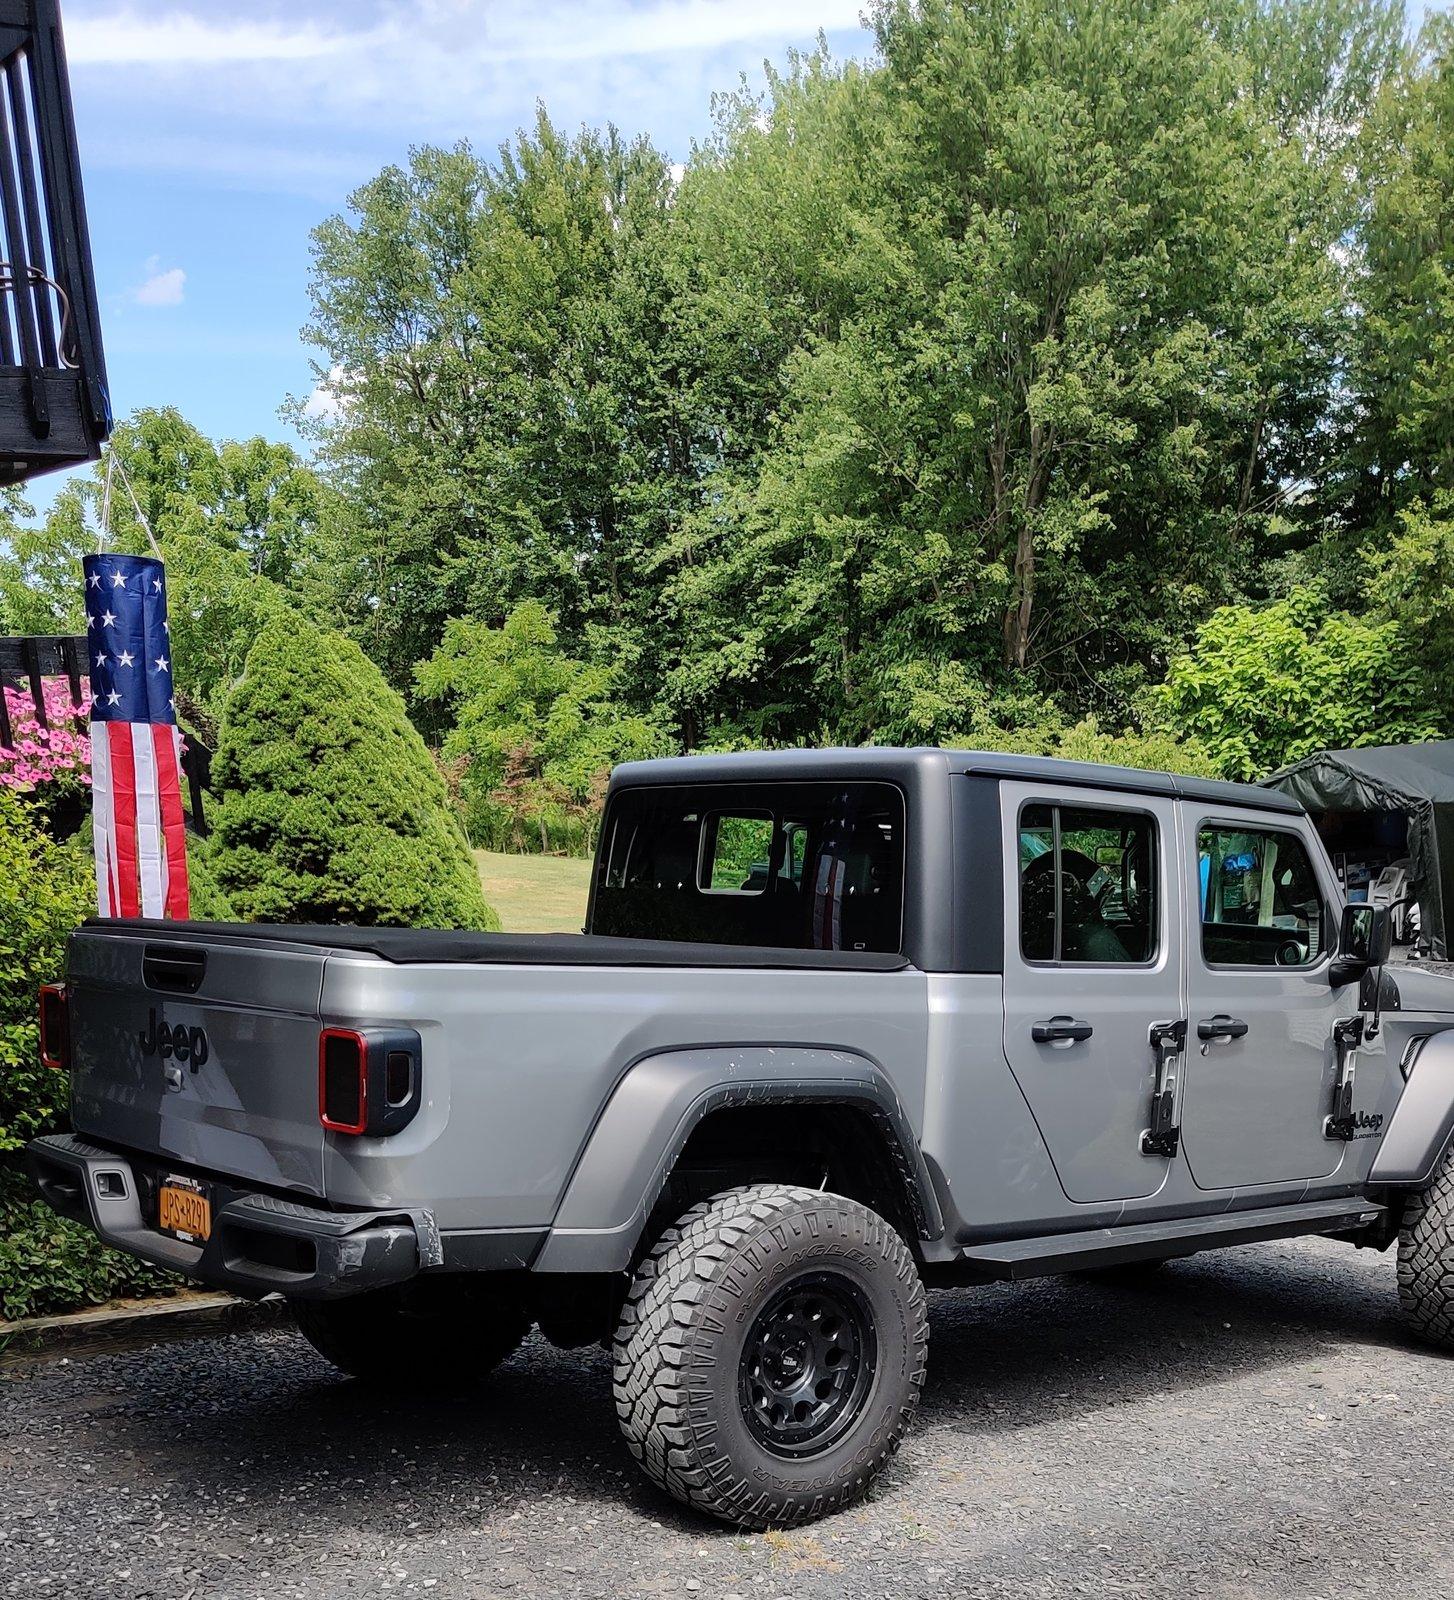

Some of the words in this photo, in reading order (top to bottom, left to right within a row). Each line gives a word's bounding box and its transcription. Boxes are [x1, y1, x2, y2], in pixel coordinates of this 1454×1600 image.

[139, 1007, 208, 1074] Jeep
[1353, 1110, 1383, 1131] Jeep
[735, 1242, 879, 1323] WRANGLER
[752, 1404, 893, 1492] GOODYEAR
